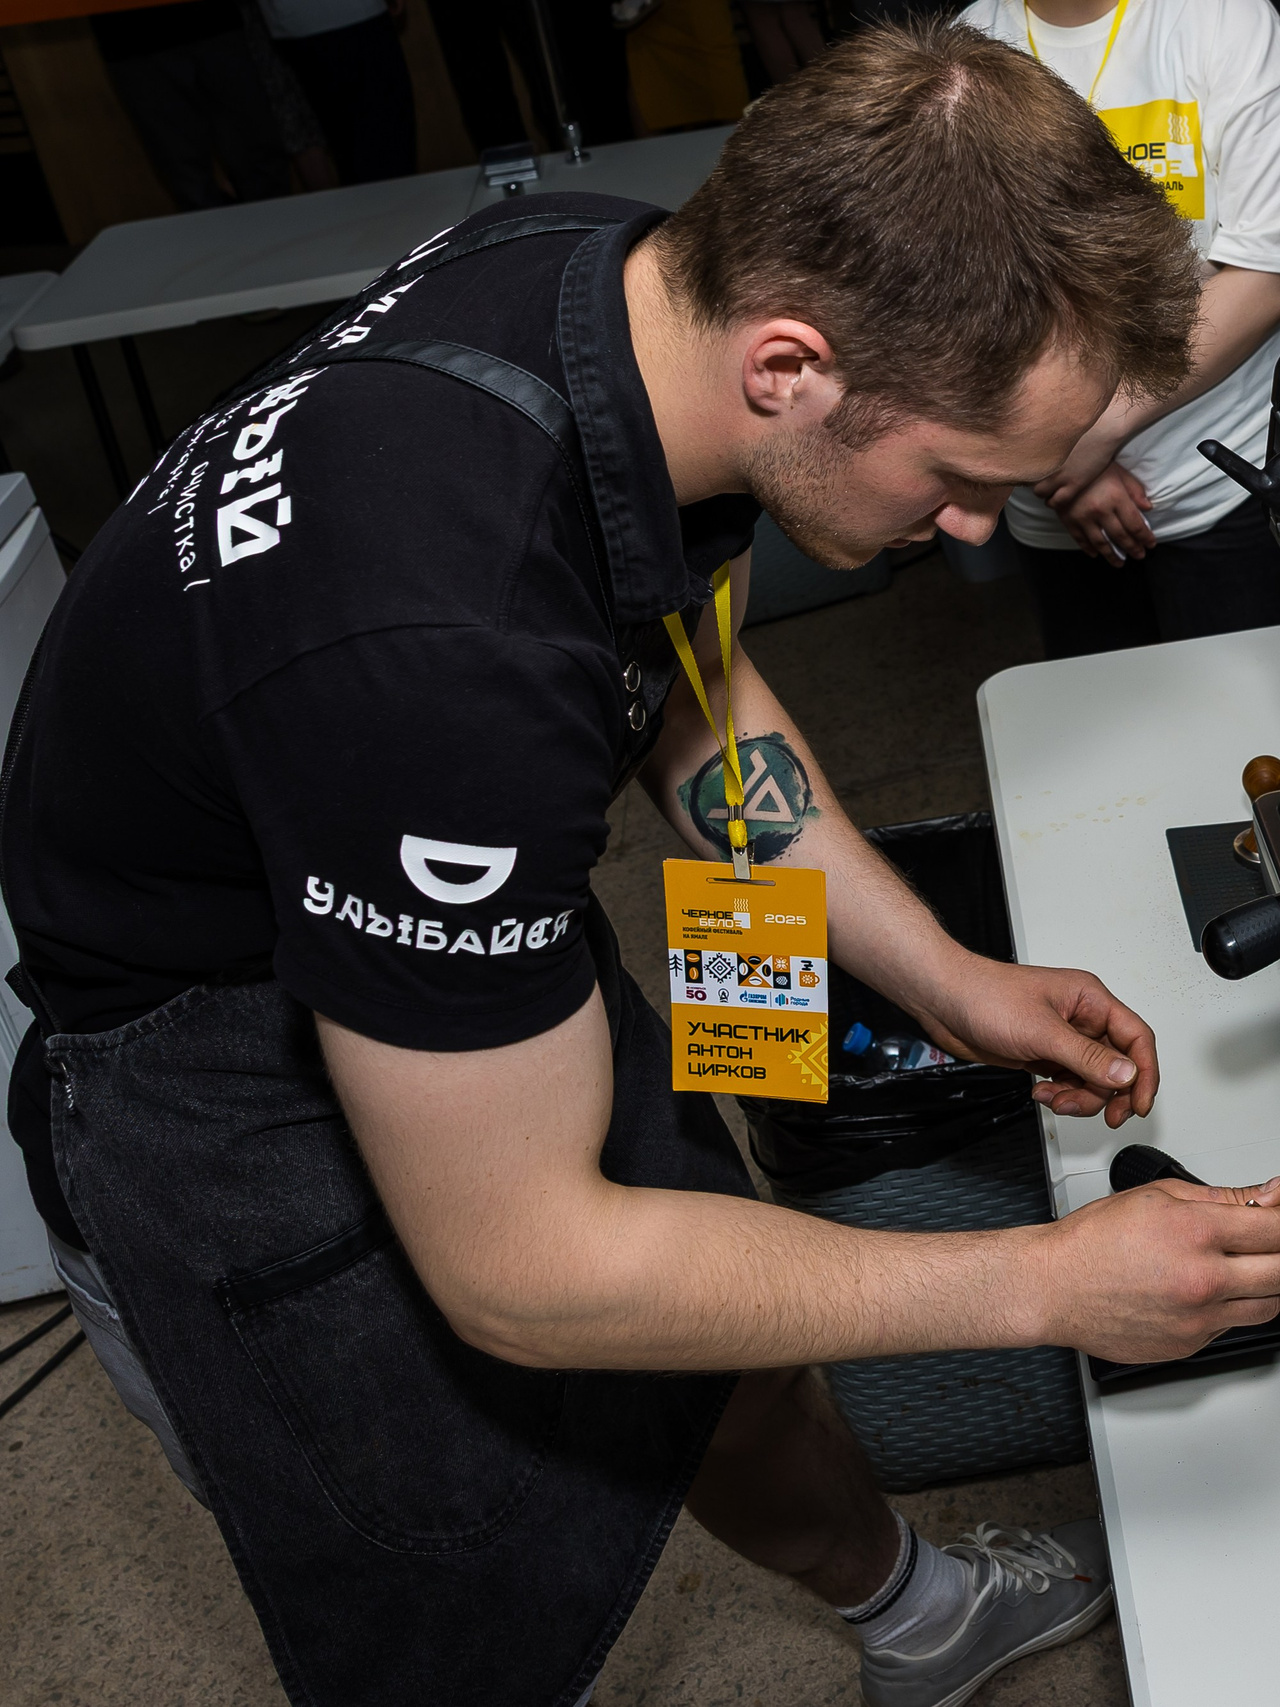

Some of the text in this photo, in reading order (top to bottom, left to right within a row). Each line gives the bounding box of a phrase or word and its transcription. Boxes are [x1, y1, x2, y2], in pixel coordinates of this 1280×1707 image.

[1121, 142, 1166, 161] НОЕ
[303, 875, 575, 956] УЛЫБАЙСЯ
[681, 908, 734, 920] ЧЕРНОЕ
[764, 913, 807, 926] 2025
[712, 928, 743, 936] ФЕСТИВАЛЬ
[686, 989, 707, 1002] 50
[687, 1021, 810, 1044] УЧАСТНИК
[687, 1043, 753, 1060] АНТОН
[687, 1062, 766, 1080] ЦИРКОВ
